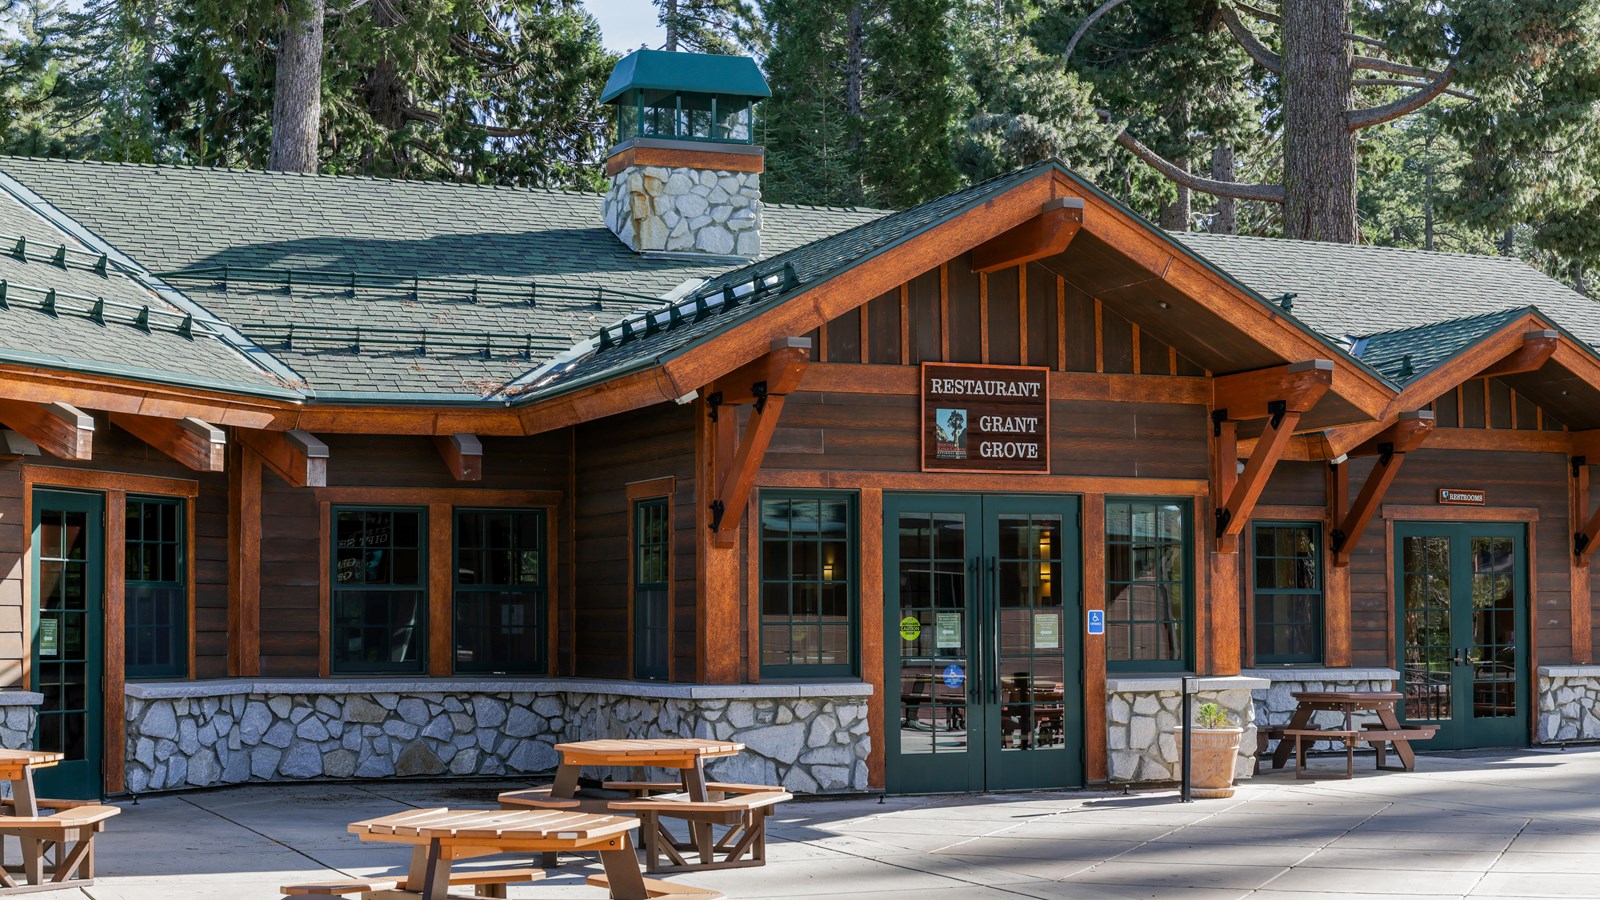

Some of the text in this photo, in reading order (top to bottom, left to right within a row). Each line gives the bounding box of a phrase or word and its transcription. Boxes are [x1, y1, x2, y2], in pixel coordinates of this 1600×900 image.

[931, 378, 1040, 397] RESTAURANT
[979, 415, 1038, 433] GRANT
[979, 441, 1038, 459] GROVE
